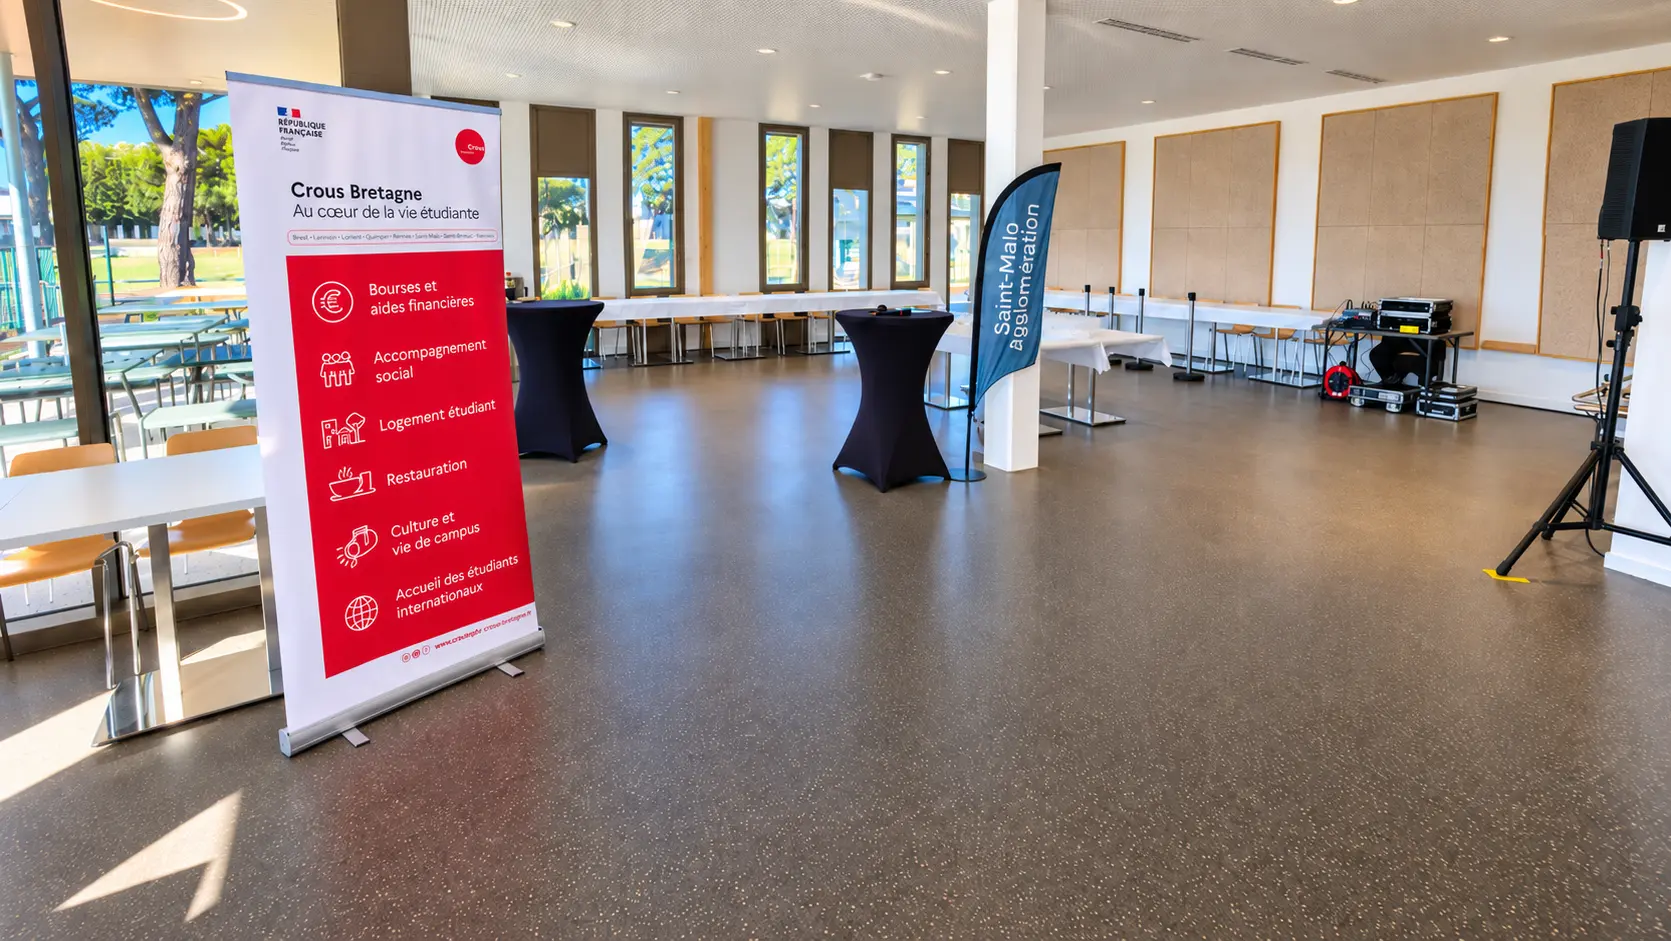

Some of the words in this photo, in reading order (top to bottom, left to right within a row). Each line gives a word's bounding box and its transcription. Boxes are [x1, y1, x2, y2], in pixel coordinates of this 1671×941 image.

[278, 118, 326, 130] RÉPUBLIQUE
[279, 127, 323, 138] FRANÇAISE
[467, 144, 485, 152] Crous
[291, 181, 345, 199] Crous
[350, 184, 423, 204] Bretagne
[293, 204, 313, 218] Au
[317, 206, 358, 218] cœur
[362, 205, 380, 218] de
[384, 205, 395, 219] la
[398, 206, 418, 219] vie
[420, 206, 480, 219] étudiante
[369, 282, 421, 296] Bourses
[424, 281, 437, 292] et
[993, 222, 1020, 336] Saint-Malo
[1009, 203, 1040, 352] agglomération
[370, 302, 405, 316] aides
[408, 295, 475, 312] financières
[374, 339, 487, 365] Accompagnement
[375, 366, 414, 383] social
[379, 408, 445, 432] Logement
[448, 399, 496, 419] étudiant
[387, 459, 468, 487] Restauration
[390, 517, 439, 538] Culture
[442, 511, 456, 524] et
[391, 542, 412, 556] vie
[415, 535, 431, 550] de
[434, 522, 481, 545] campus
[444, 570, 465, 587] des
[467, 555, 519, 577] étudiants
[396, 582, 483, 619] internationaux
